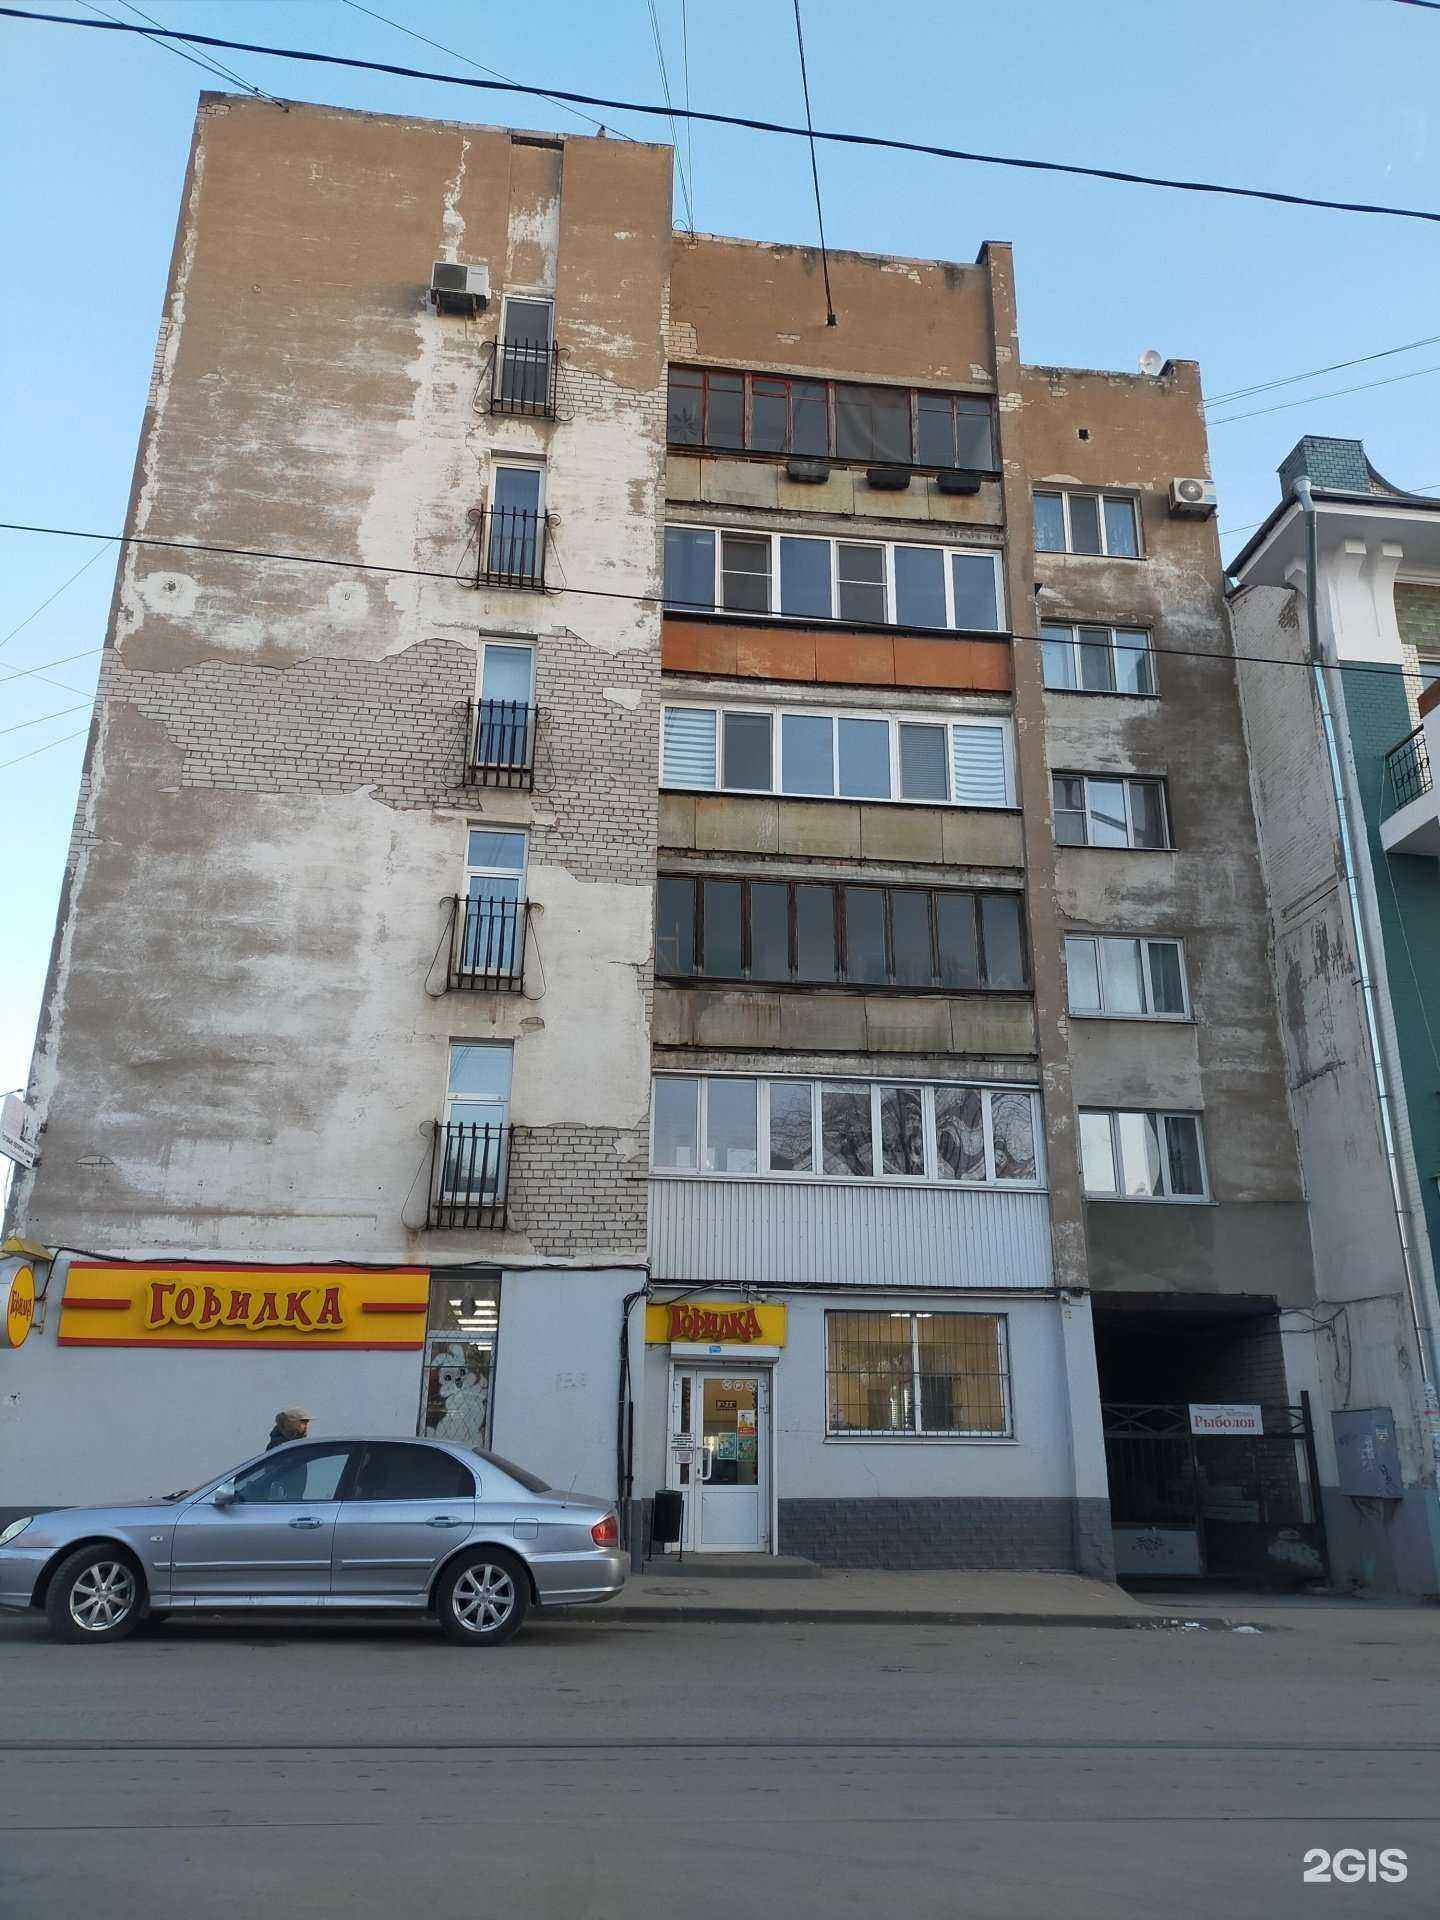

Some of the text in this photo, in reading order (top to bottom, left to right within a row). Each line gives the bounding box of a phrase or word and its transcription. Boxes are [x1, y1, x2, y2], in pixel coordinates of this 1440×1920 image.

[149, 1282, 344, 1326] ГОРИЛКА
[669, 1304, 763, 1341] ГОРИЛКА
[1194, 1414, 1256, 1429] Рыболов
